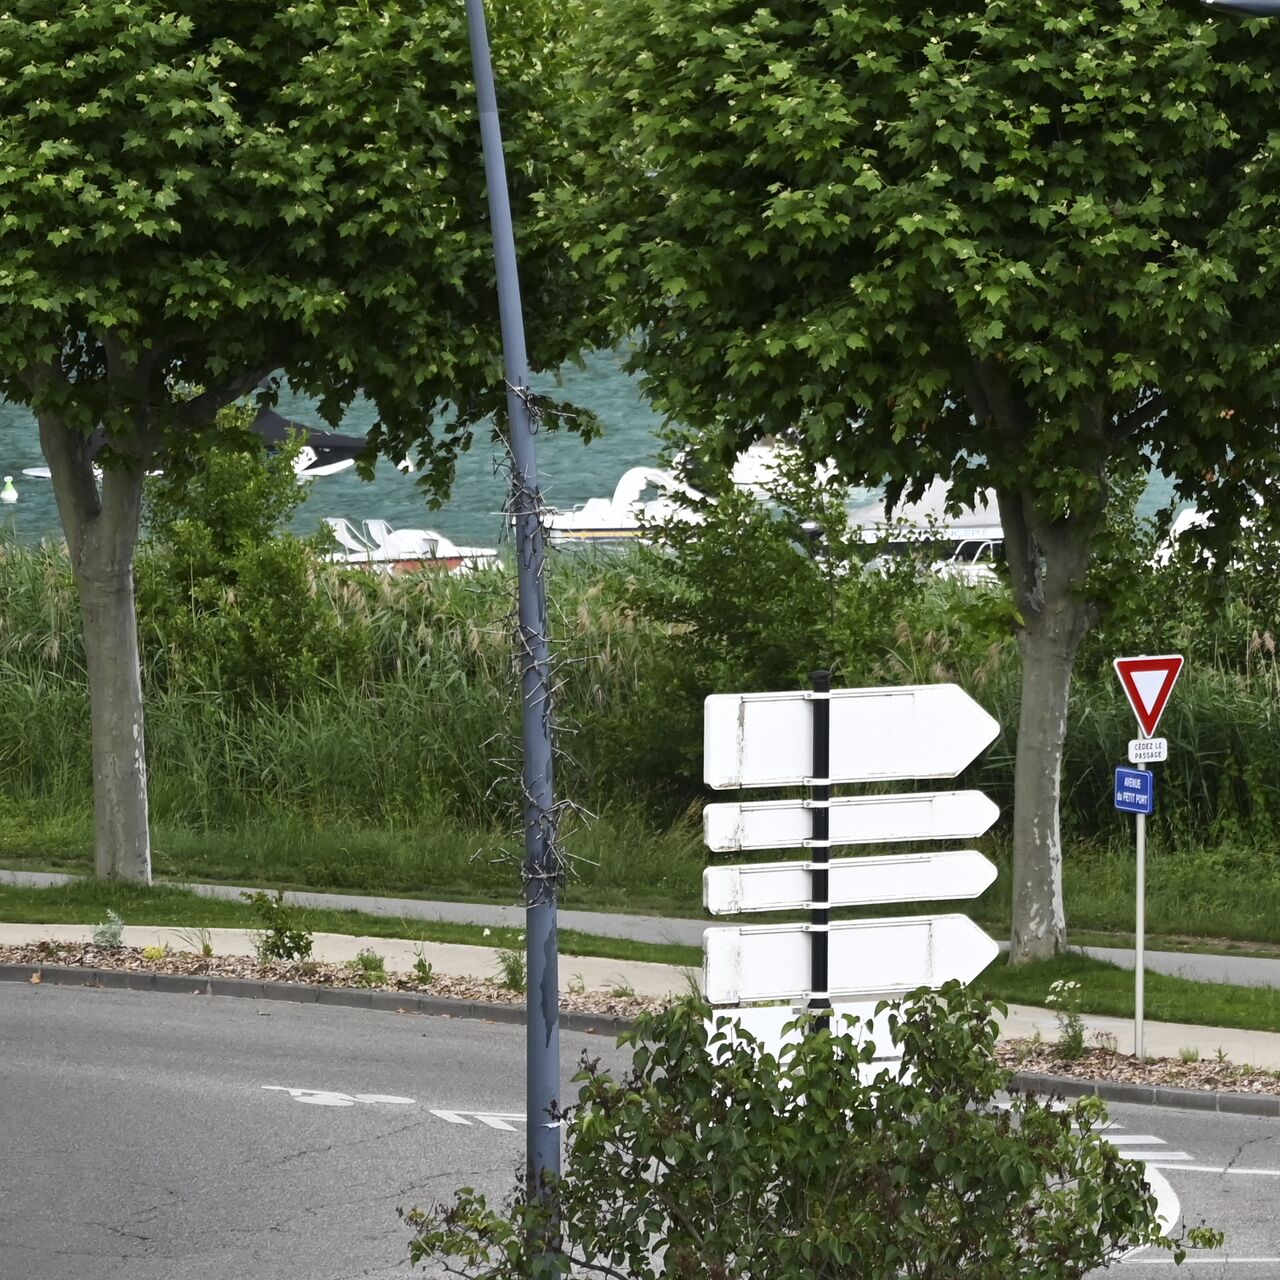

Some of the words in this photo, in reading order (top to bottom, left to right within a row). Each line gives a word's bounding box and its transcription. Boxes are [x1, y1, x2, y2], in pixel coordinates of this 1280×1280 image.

[1134, 742, 1153, 750] CÉDEZ
[1134, 751, 1162, 759] PASSAGE
[1124, 777, 1141, 789] AVENUE
[1123, 792, 1135, 802] PETIT
[1136, 794, 1147, 804] PORT
